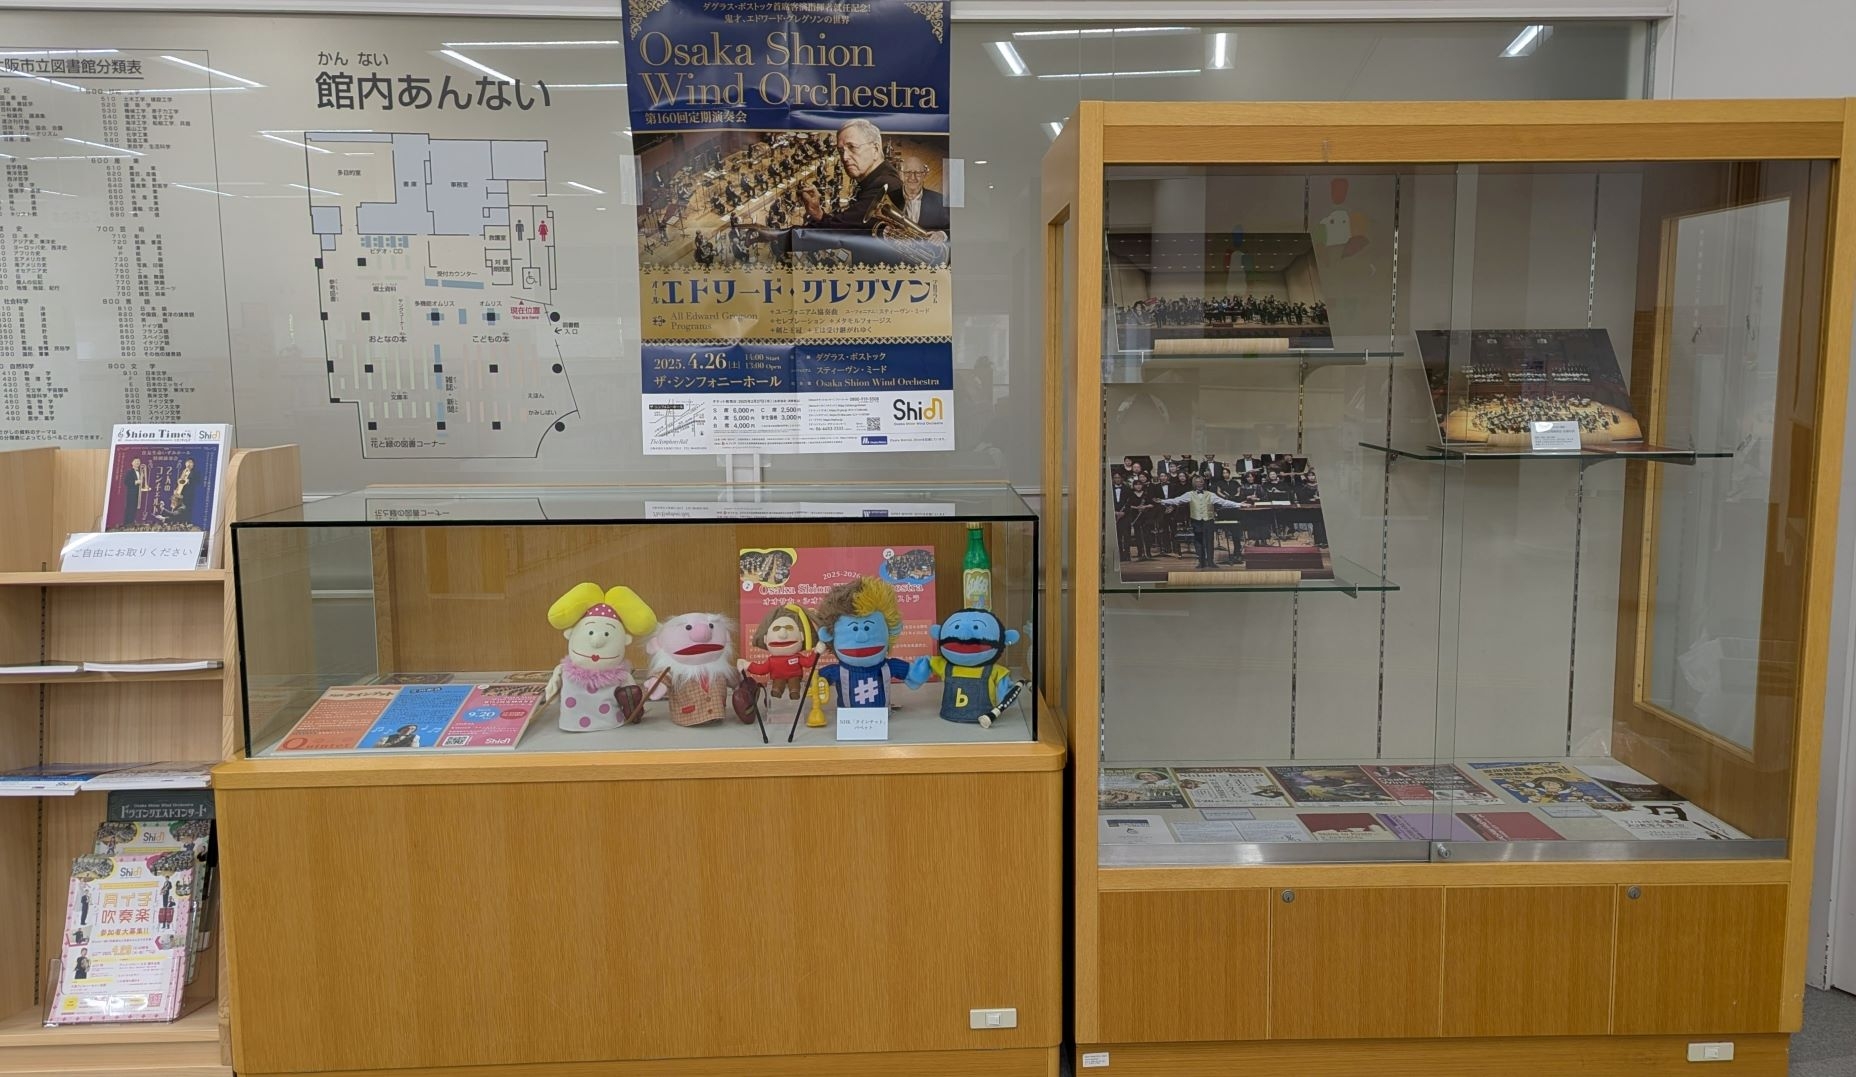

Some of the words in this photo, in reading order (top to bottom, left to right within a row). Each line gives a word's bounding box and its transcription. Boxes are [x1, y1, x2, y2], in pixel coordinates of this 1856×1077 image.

[639, 31, 755, 67] Osaka
[766, 31, 876, 68] Shion
[318, 52, 348, 66] かん
[358, 52, 389, 66] ない
[0, 58, 143, 74] 阪市立図書館分類表
[316, 71, 551, 111] 館内あんない
[638, 72, 747, 108] Wind
[758, 71, 940, 108] Orchestra
[644, 110, 748, 124] 第160回定期演奏会
[662, 278, 930, 304] エドワード・グレグソン
[510, 306, 540, 314] 現在位置
[672, 312, 684, 320] All
[684, 312, 720, 320] Edward
[654, 359, 685, 370] 2025.
[688, 352, 726, 370] 4.26
[816, 353, 886, 361] ダグラス・ボストック
[816, 366, 887, 374] スティーヴン・ミード
[654, 376, 782, 388] ザ・シンフォニーホール
[872, 378, 895, 386] Wind
[898, 378, 939, 386] Orchestra
[126, 429, 156, 438] Shion
[159, 429, 191, 438] Times
[72, 548, 192, 558] ご自由にお取りください
[823, 571, 861, 580] 2025-2026
[759, 585, 796, 595] Osaka
[101, 908, 150, 924] 吹奏楽
